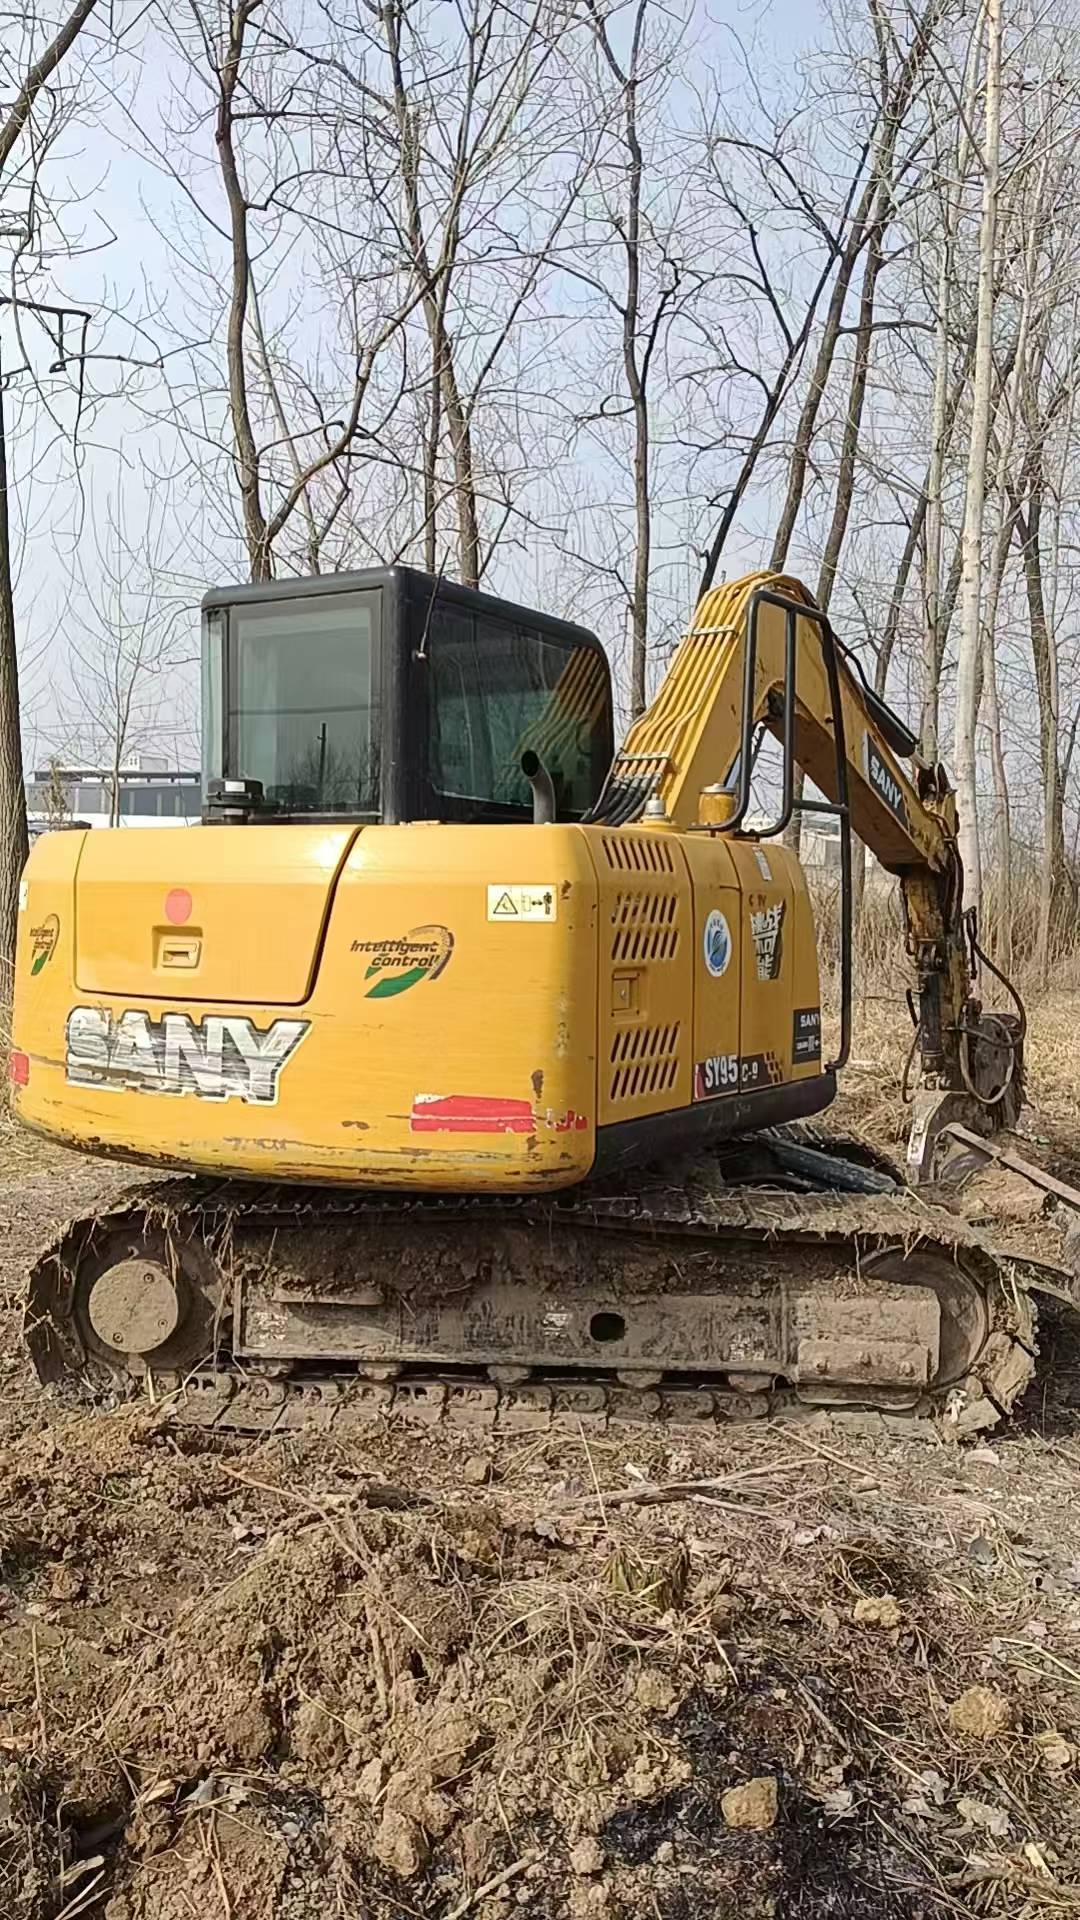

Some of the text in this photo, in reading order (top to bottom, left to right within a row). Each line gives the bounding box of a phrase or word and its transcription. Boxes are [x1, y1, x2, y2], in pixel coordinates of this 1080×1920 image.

[869, 755, 902, 809] SANY
[350, 936, 439, 956] Intelligent
[371, 954, 435, 967] control
[66, 1005, 312, 1105] SANY
